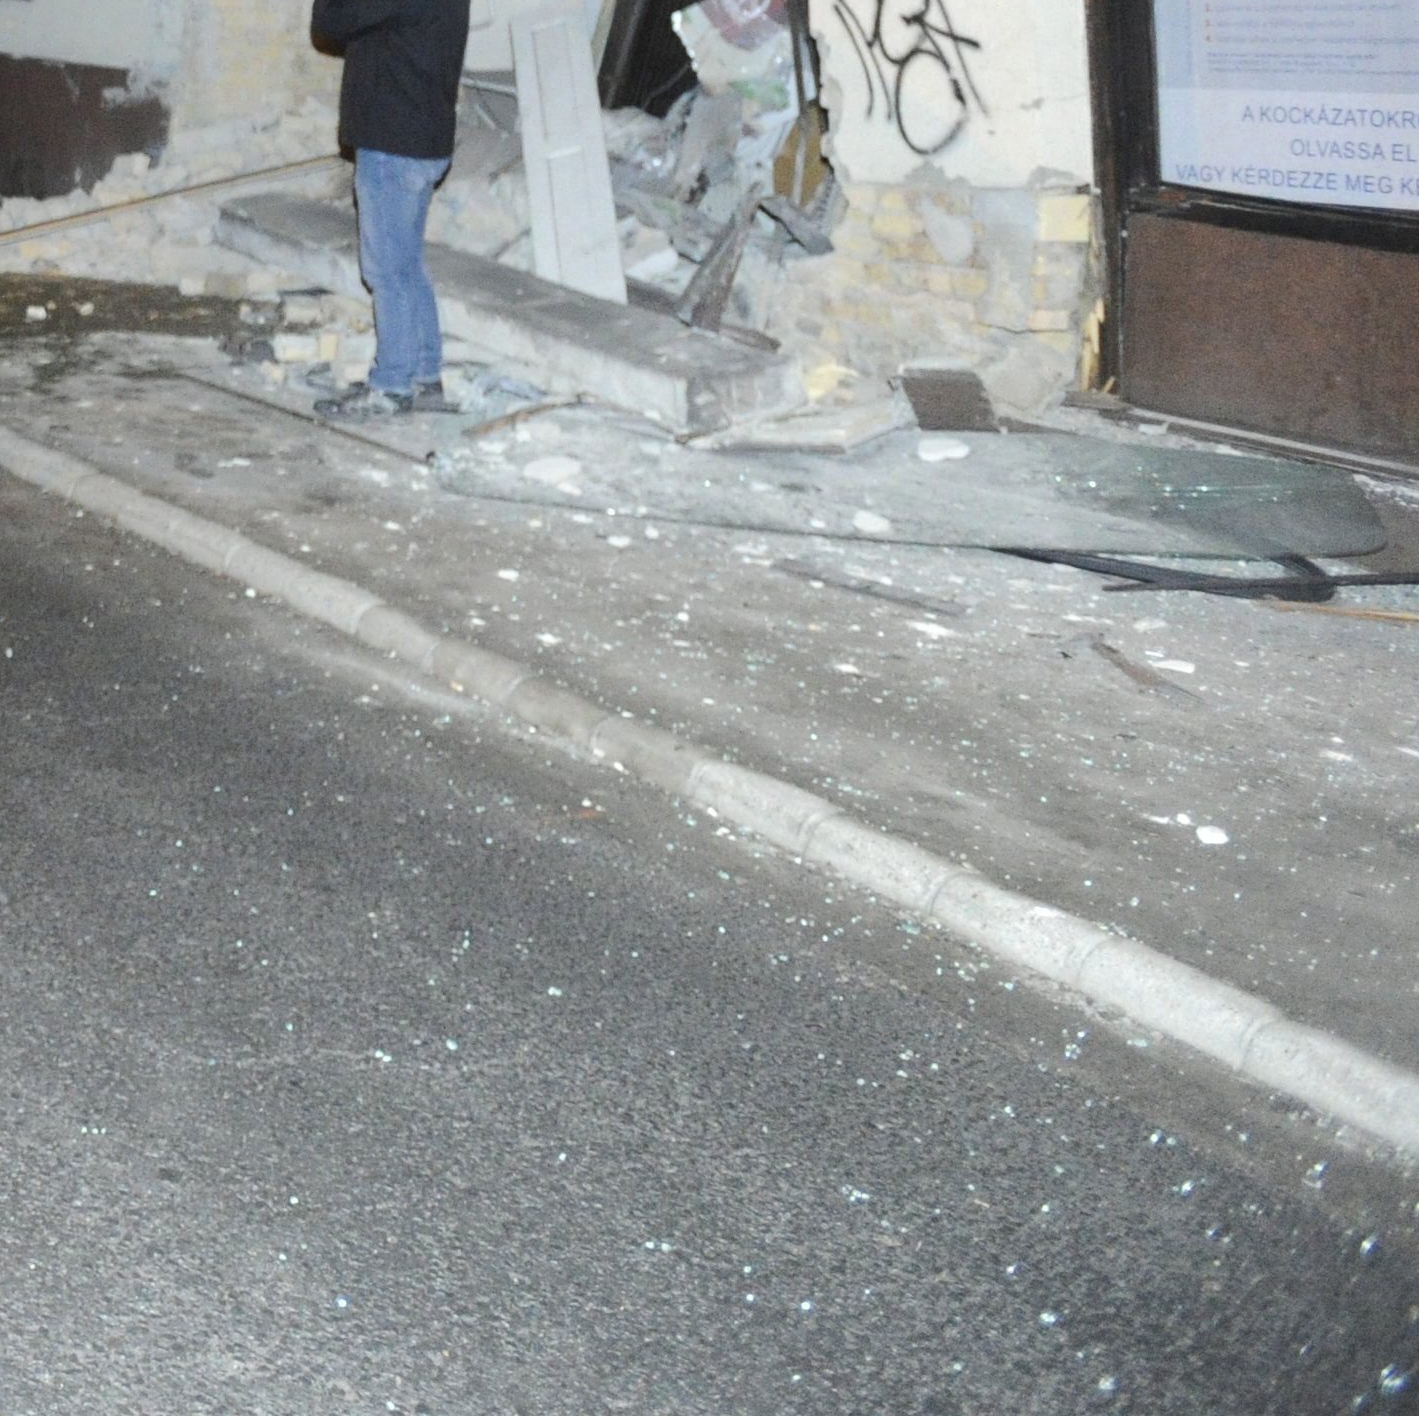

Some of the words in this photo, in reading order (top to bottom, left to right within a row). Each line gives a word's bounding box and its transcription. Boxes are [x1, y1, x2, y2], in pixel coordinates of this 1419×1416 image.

[1242, 105, 1255, 123] A
[1259, 103, 1419, 129] KOCKÁZATOKR
[1290, 139, 1385, 161] OLVASSA
[1391, 143, 1417, 163] EL
[1175, 164, 1226, 183] VAGY
[1231, 167, 1337, 191] KÉRDEZZE
[1345, 174, 1393, 195] MEG
[1400, 176, 1419, 197] K
